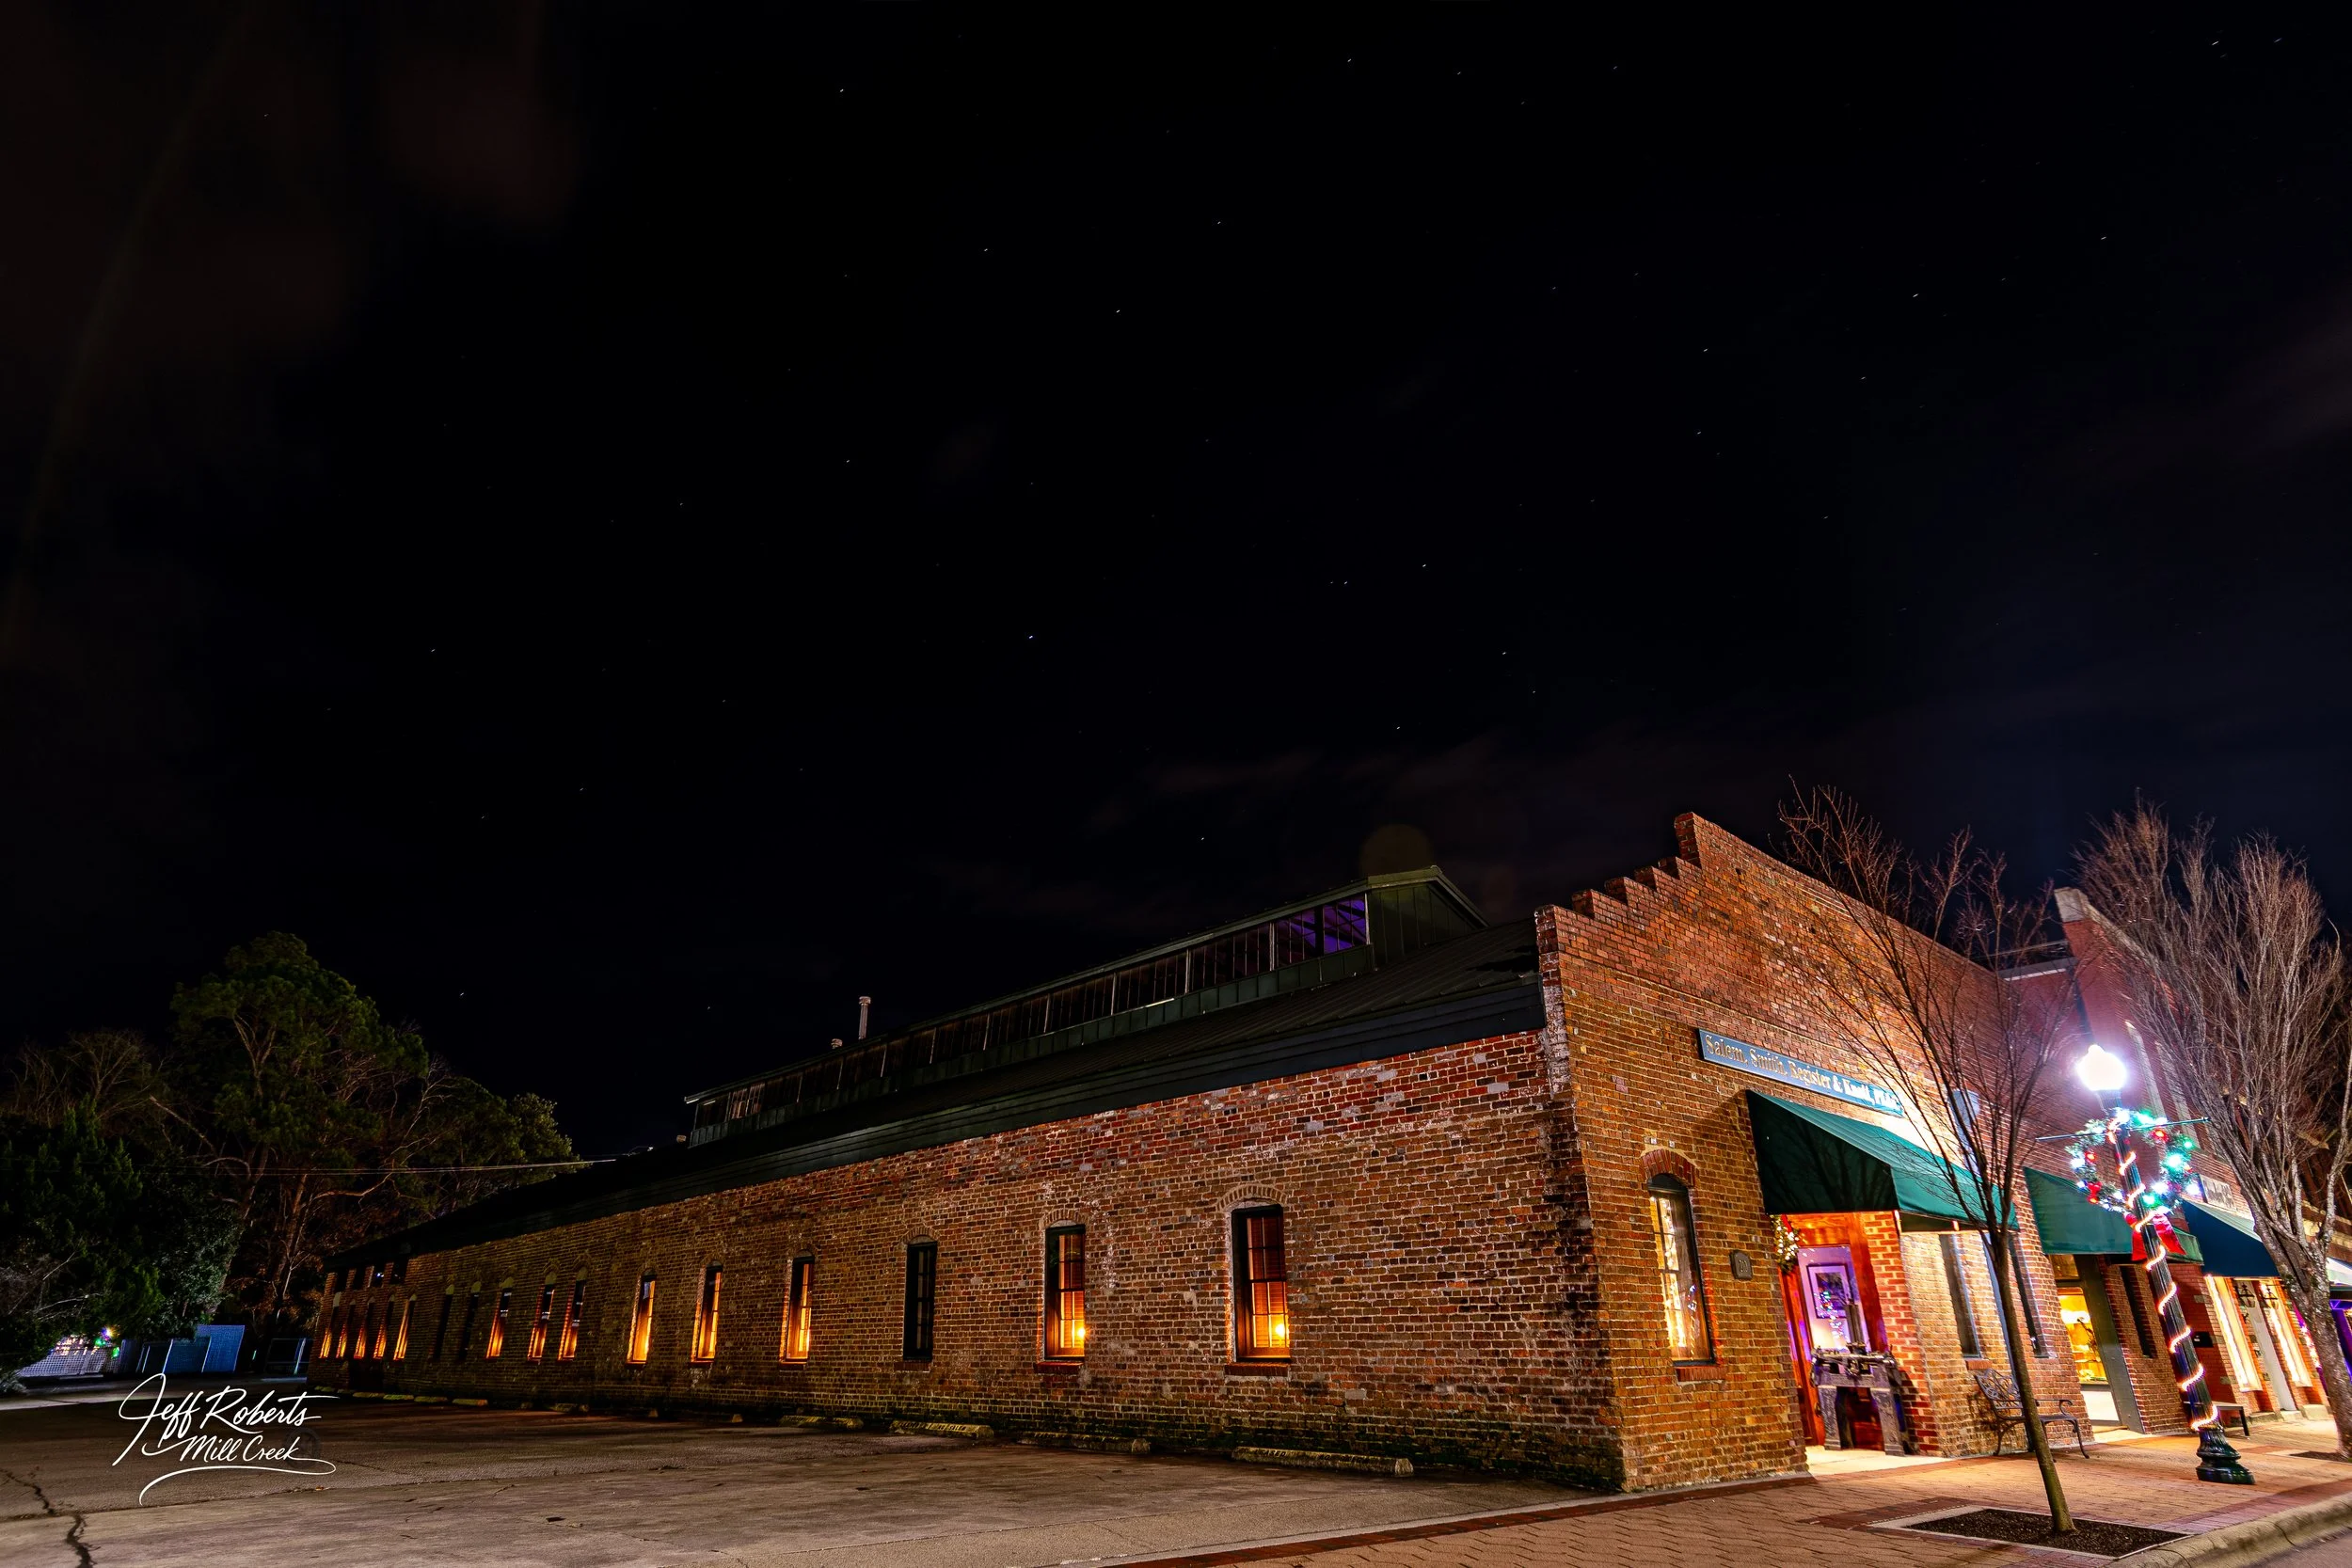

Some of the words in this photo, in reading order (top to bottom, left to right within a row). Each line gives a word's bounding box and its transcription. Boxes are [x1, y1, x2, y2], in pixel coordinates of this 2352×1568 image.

[1705, 1034, 1749, 1068] Salem,
[1750, 1048, 1788, 1077] Smith,
[1788, 1060, 1831, 1089] Register
[1833, 1075, 1844, 1093] &
